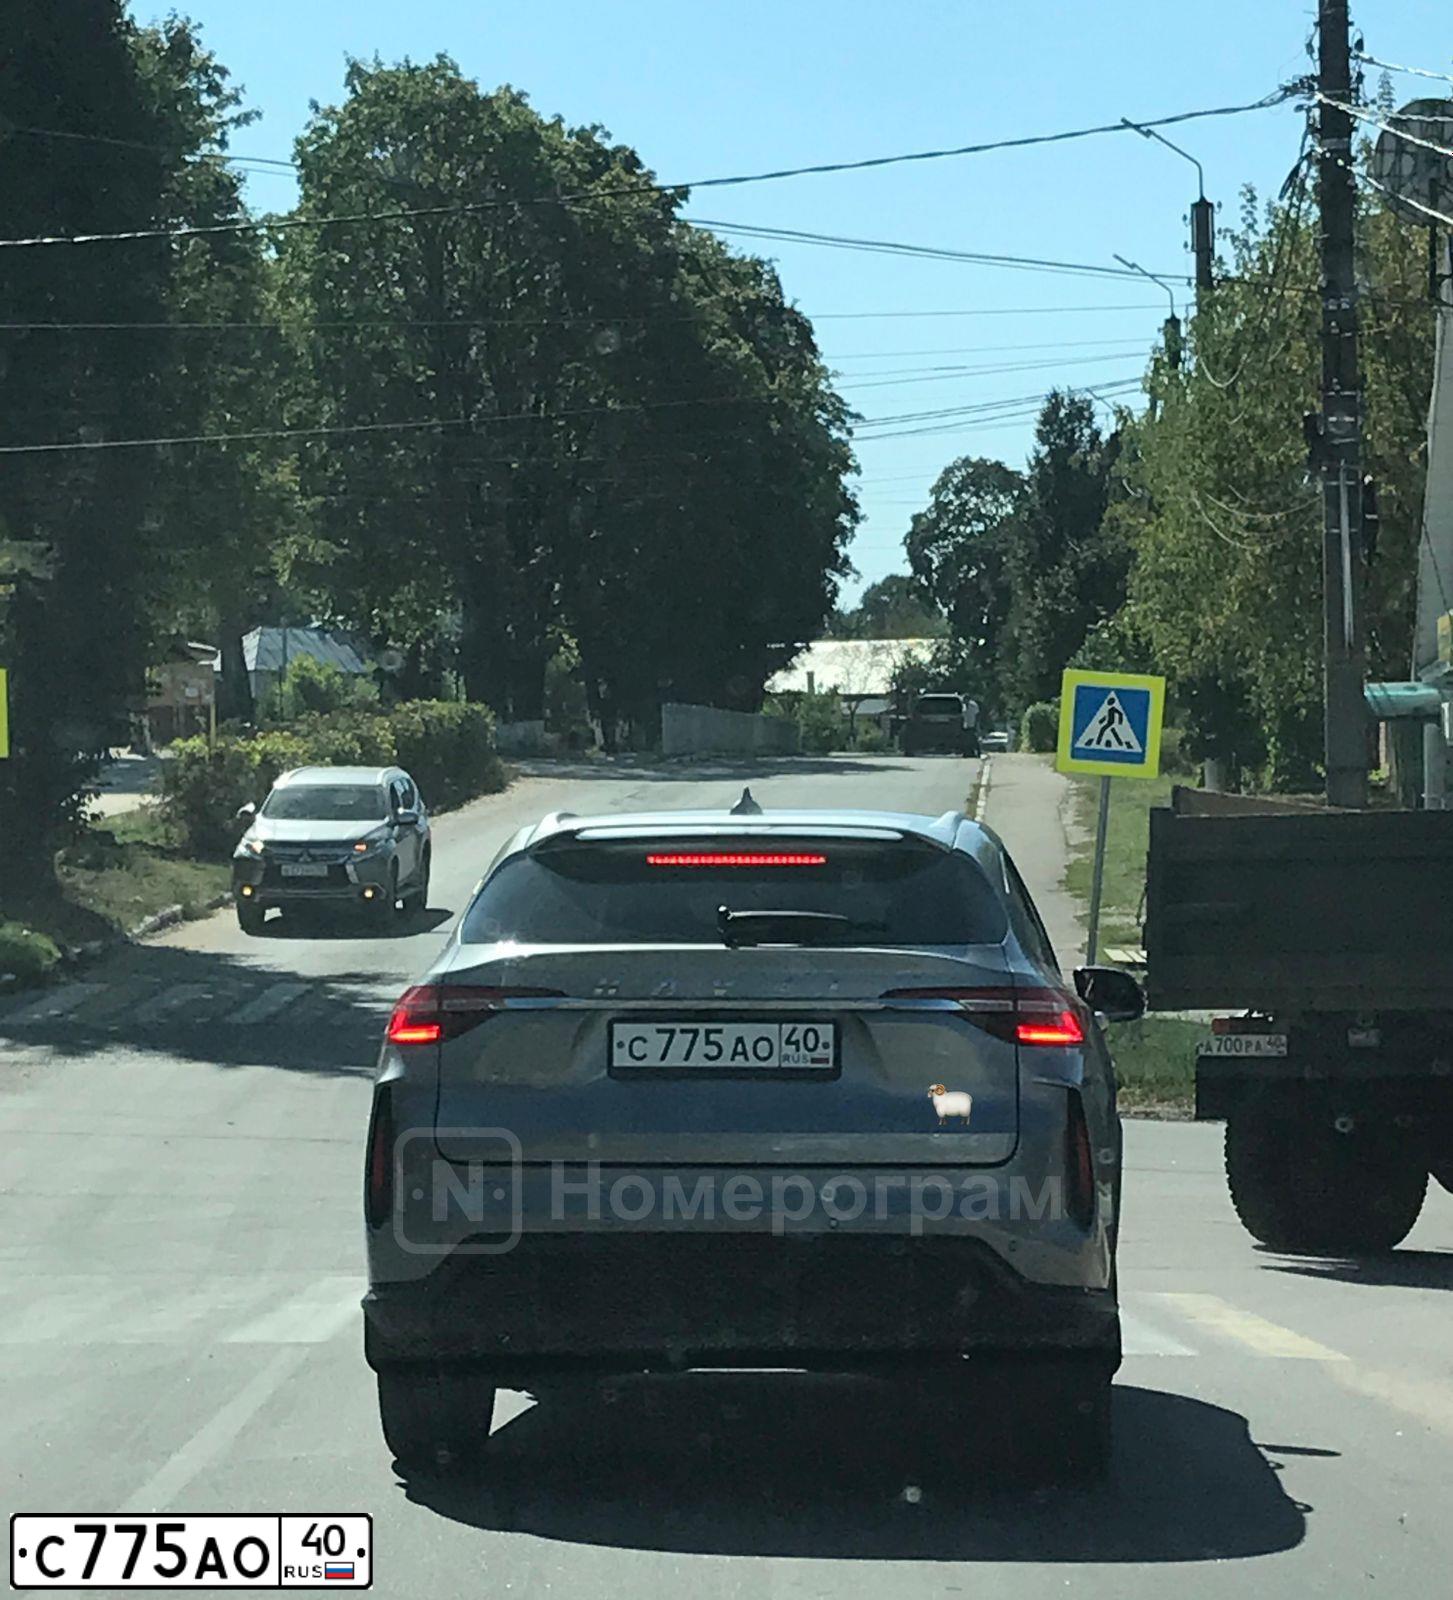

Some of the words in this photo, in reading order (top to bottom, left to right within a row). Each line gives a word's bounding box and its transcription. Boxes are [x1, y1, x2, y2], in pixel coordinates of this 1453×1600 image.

[628, 1028, 774, 1062] С775АО
[785, 1027, 820, 1052] 40
[1204, 1036, 1262, 1053] А700РА
[782, 1053, 809, 1064] RUS
